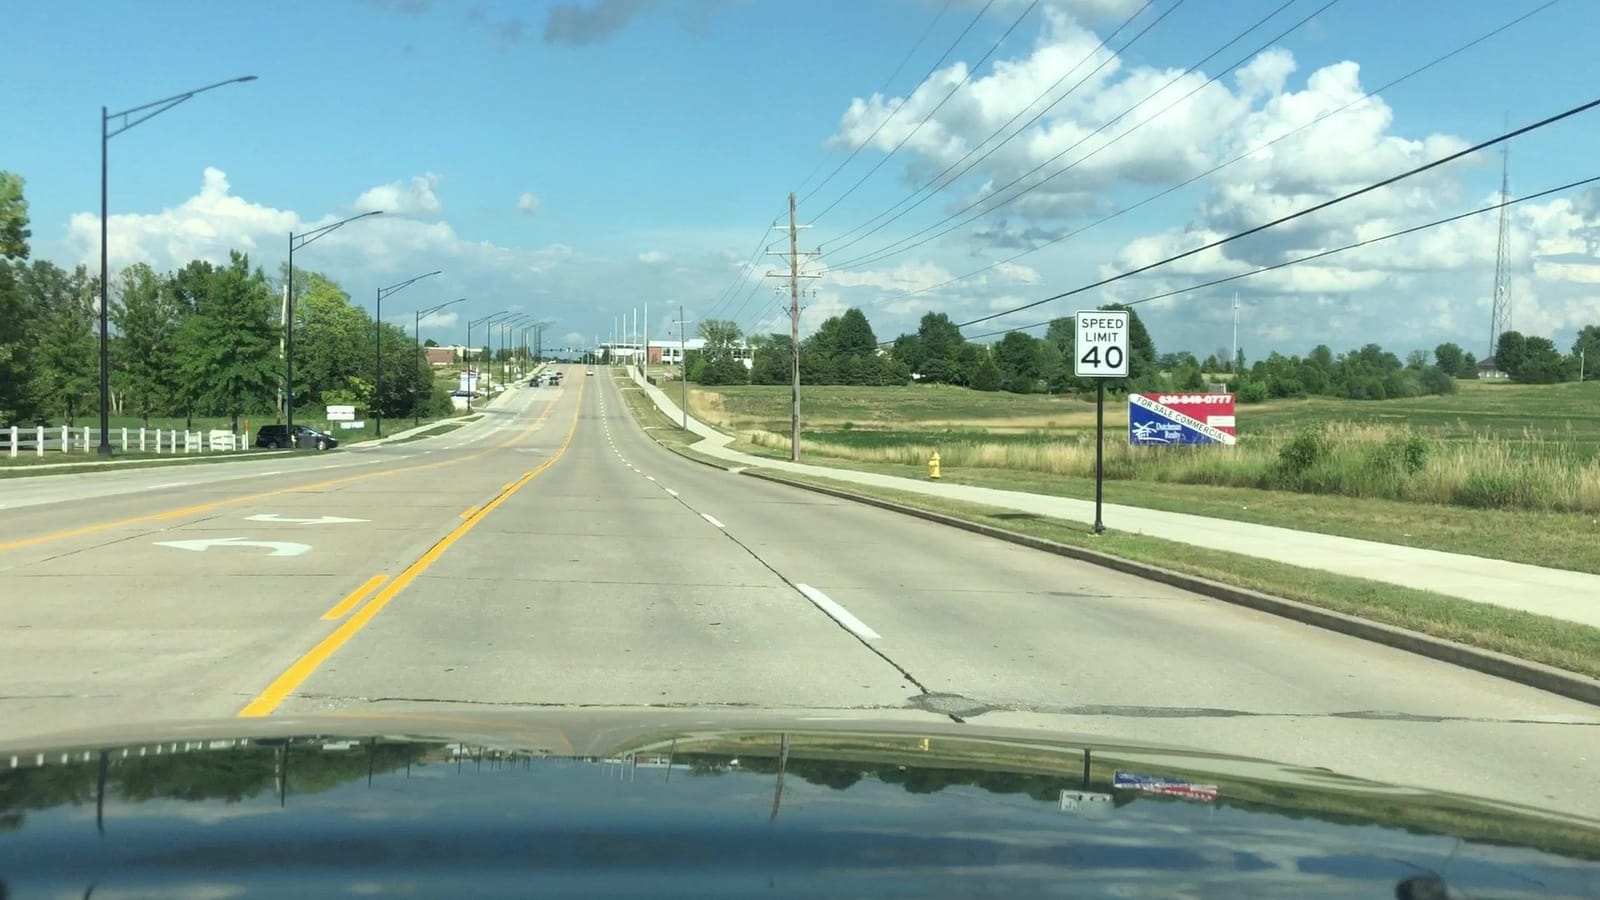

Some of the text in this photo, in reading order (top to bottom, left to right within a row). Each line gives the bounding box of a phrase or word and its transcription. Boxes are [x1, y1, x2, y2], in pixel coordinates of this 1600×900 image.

[1081, 318, 1124, 328] SPEED
[1085, 332, 1119, 342] LIMIT
[1081, 345, 1123, 368] 40
[1136, 396, 1227, 442] FOR SALE COMMERCIAL
